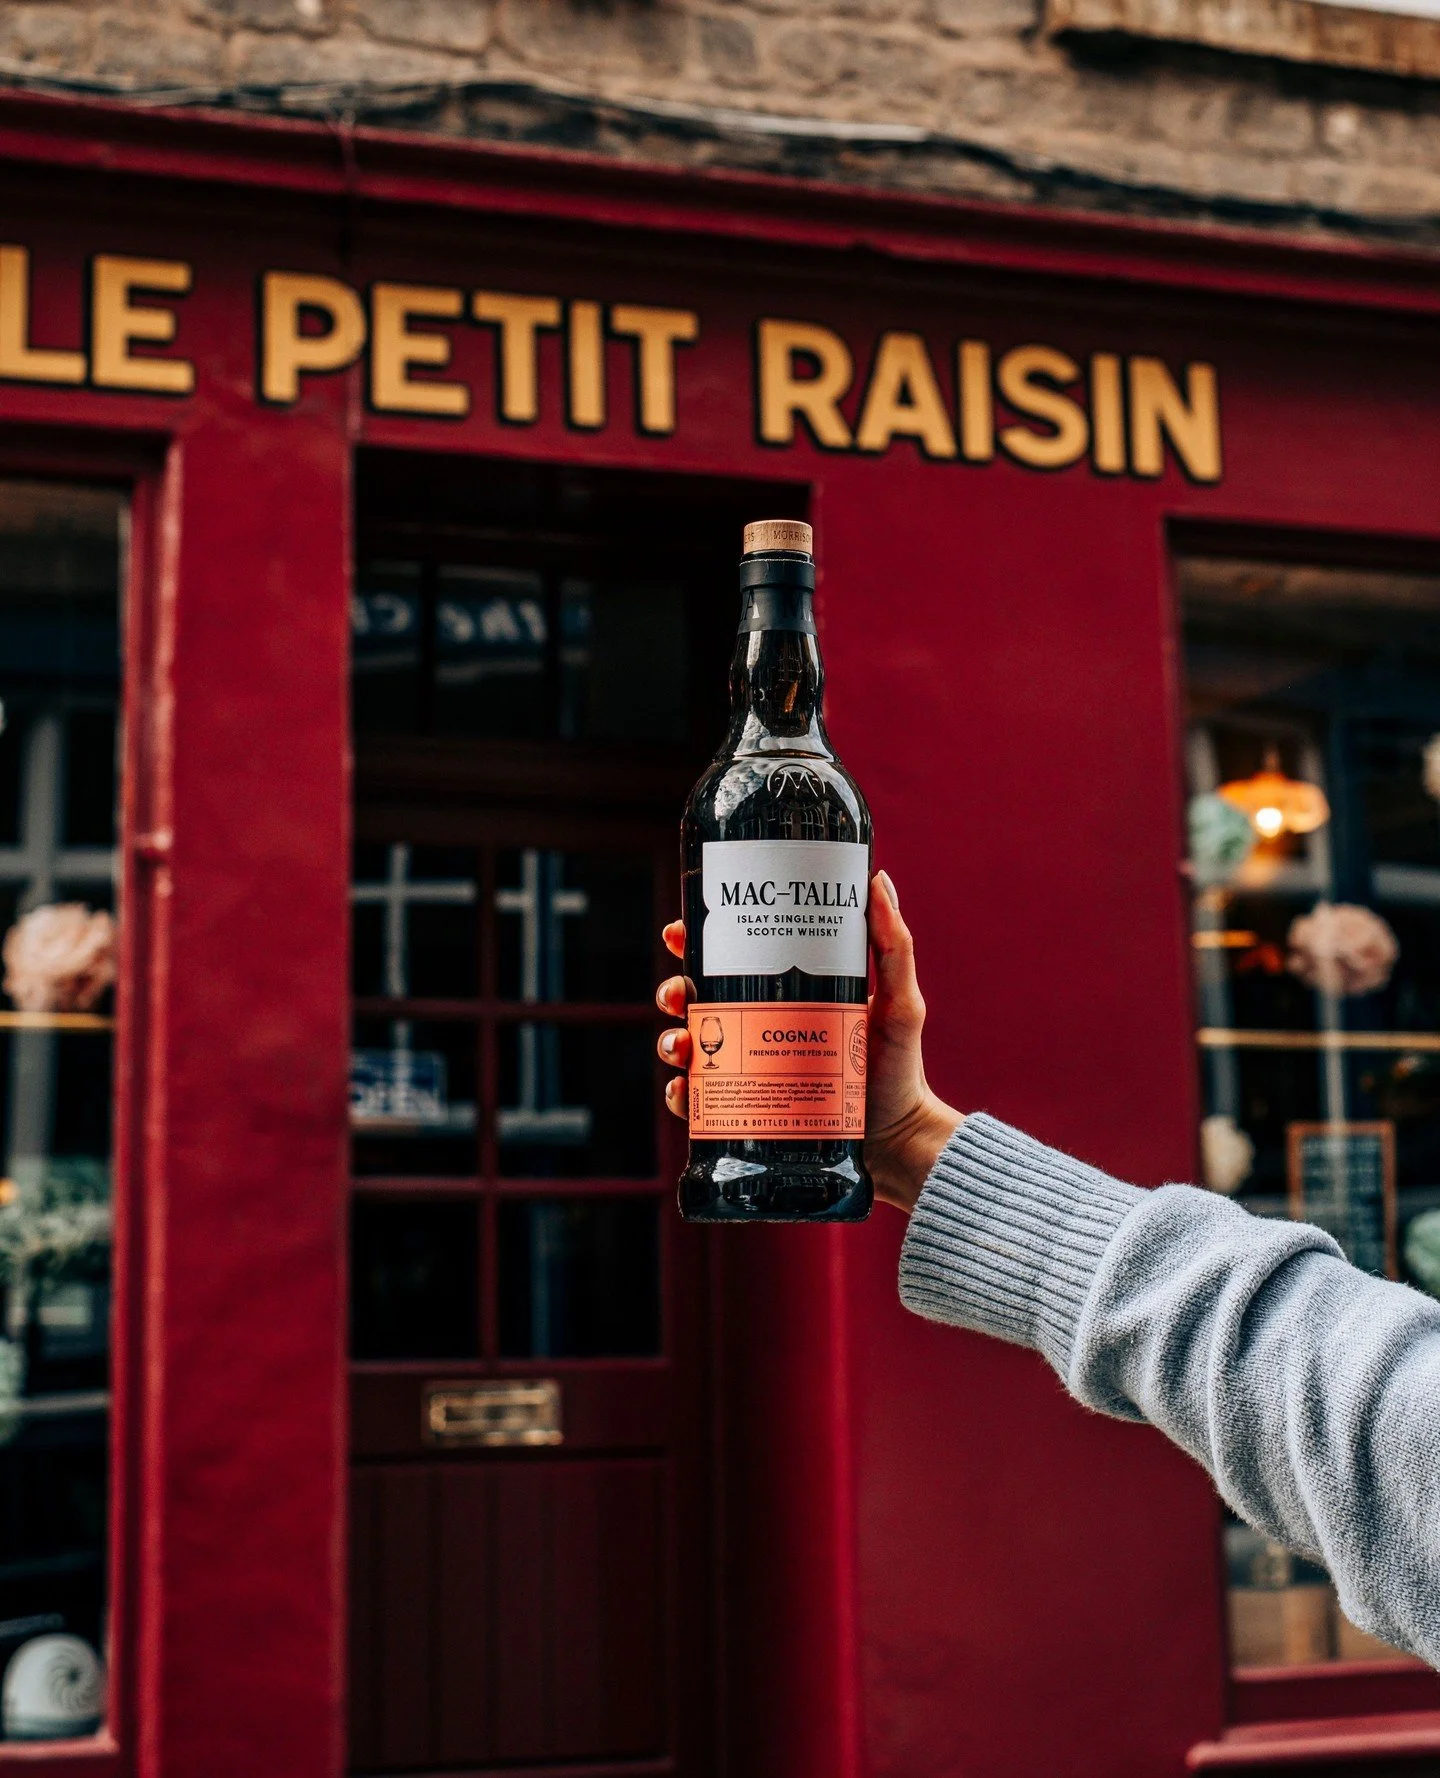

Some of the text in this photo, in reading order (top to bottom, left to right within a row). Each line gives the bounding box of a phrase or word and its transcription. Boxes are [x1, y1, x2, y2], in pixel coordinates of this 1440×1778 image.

[0, 243, 1222, 482] LE PETIT RAISIN
[720, 880, 859, 908] MAC-TALLA
[737, 914, 844, 925] ISLAY SINGLE MALT
[746, 927, 839, 937] SCOTCH WHISKY
[761, 1030, 828, 1043] COGNAC
[781, 1049, 791, 1057] OF
[705, 1119, 740, 1127] DISTILLED
[752, 1119, 788, 1127] BOTTLED
[792, 1119, 800, 1127] IN
[804, 1119, 840, 1127] SCOTLAND
